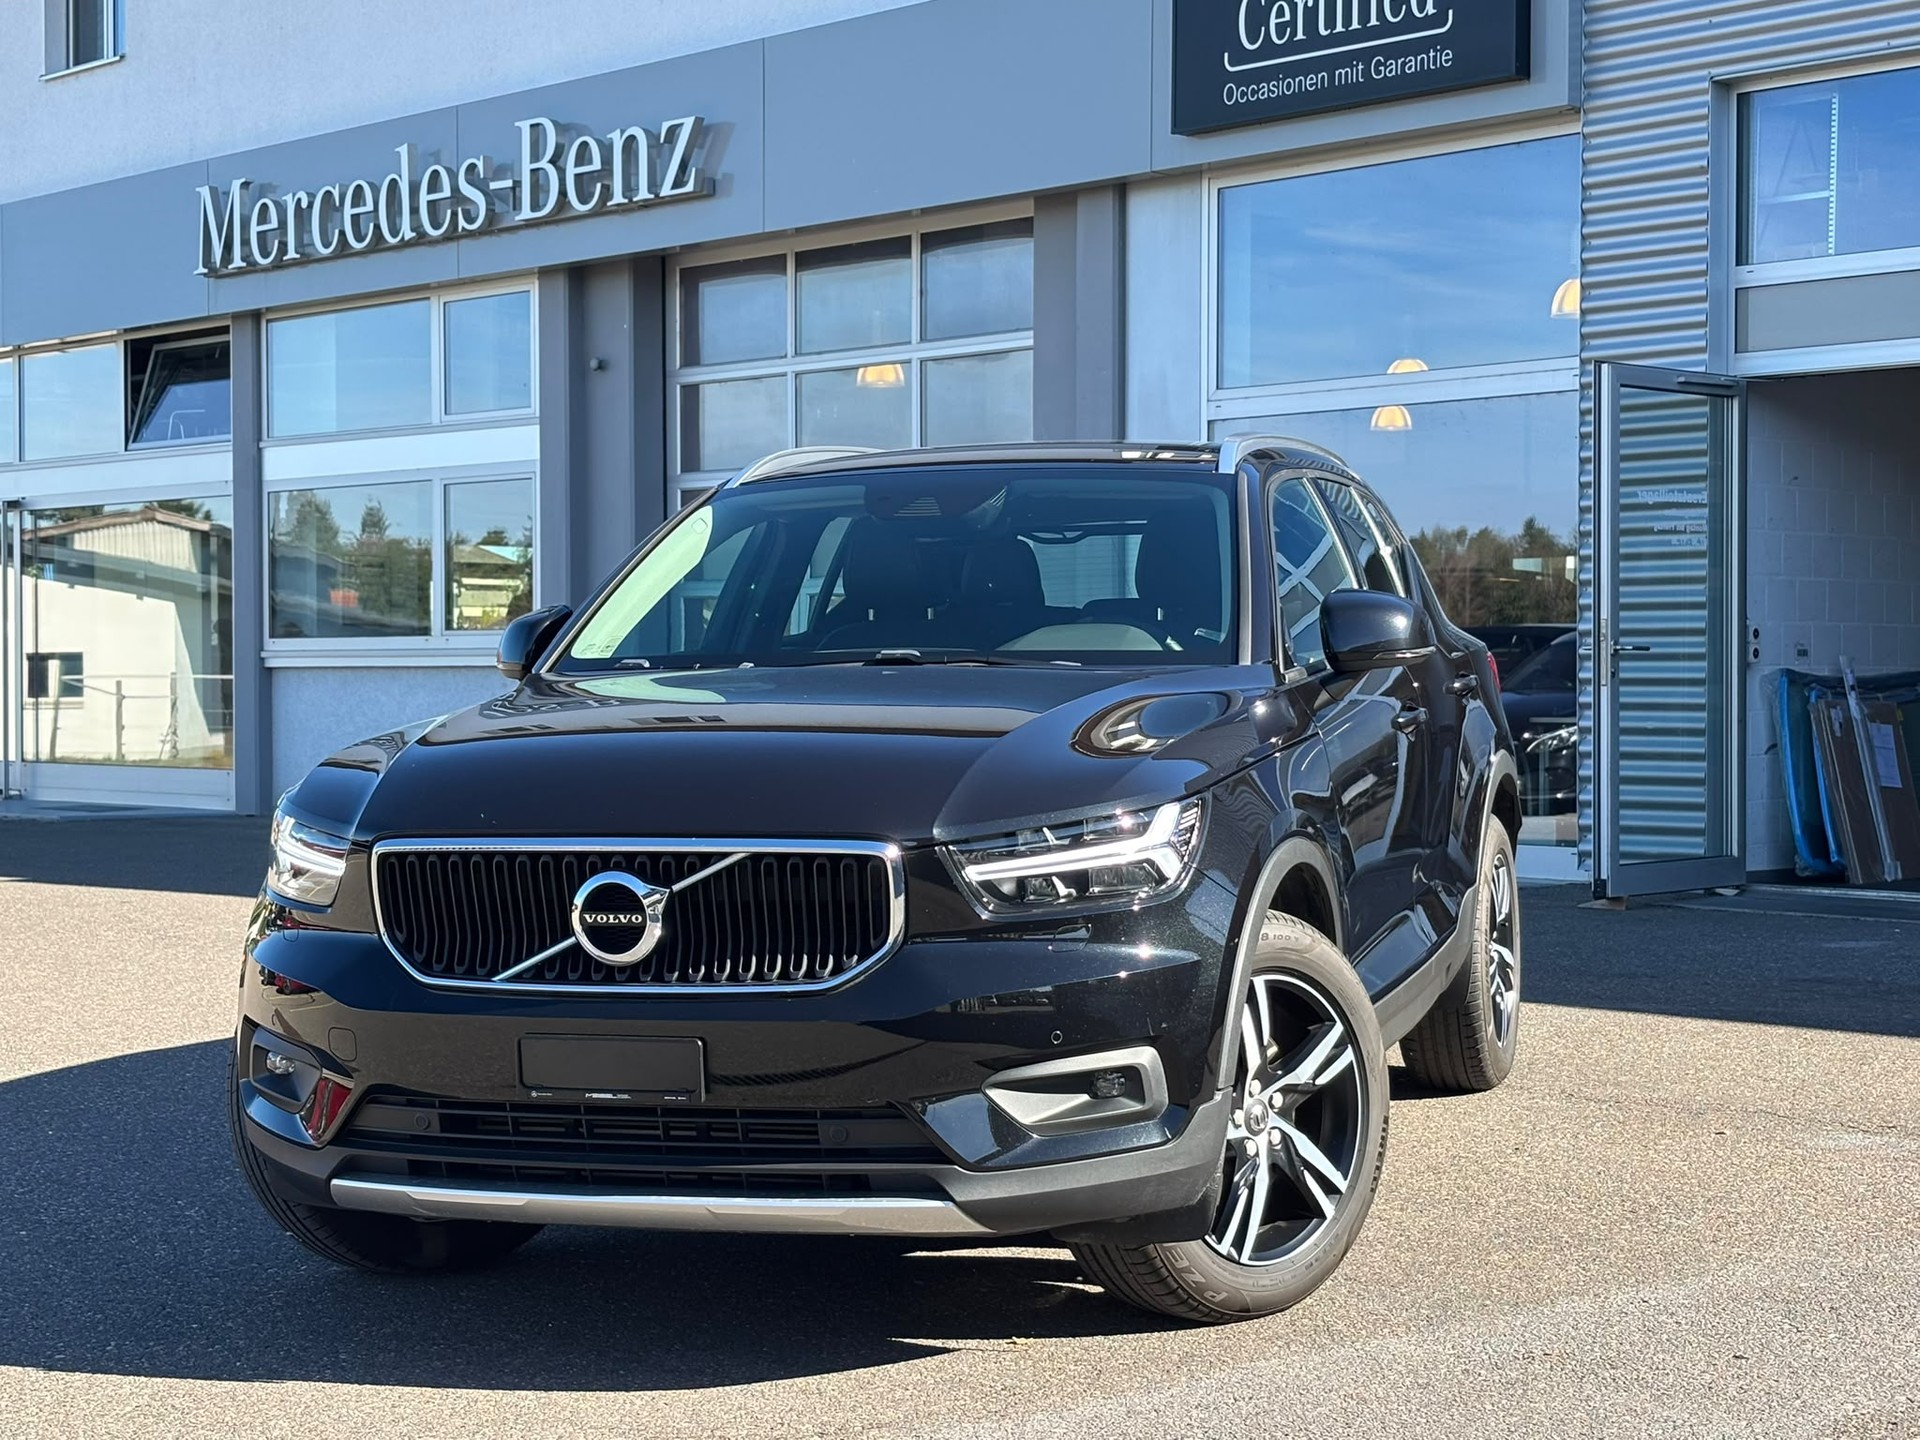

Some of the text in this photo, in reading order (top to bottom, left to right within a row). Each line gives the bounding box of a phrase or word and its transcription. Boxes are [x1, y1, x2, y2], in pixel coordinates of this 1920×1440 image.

[1238, 0, 1437, 50] Certie
[1223, 46, 1453, 105] Occasionen mit Garantie
[193, 115, 707, 276] Mercedes-Benz
[583, 914, 643, 923] VOLVO
